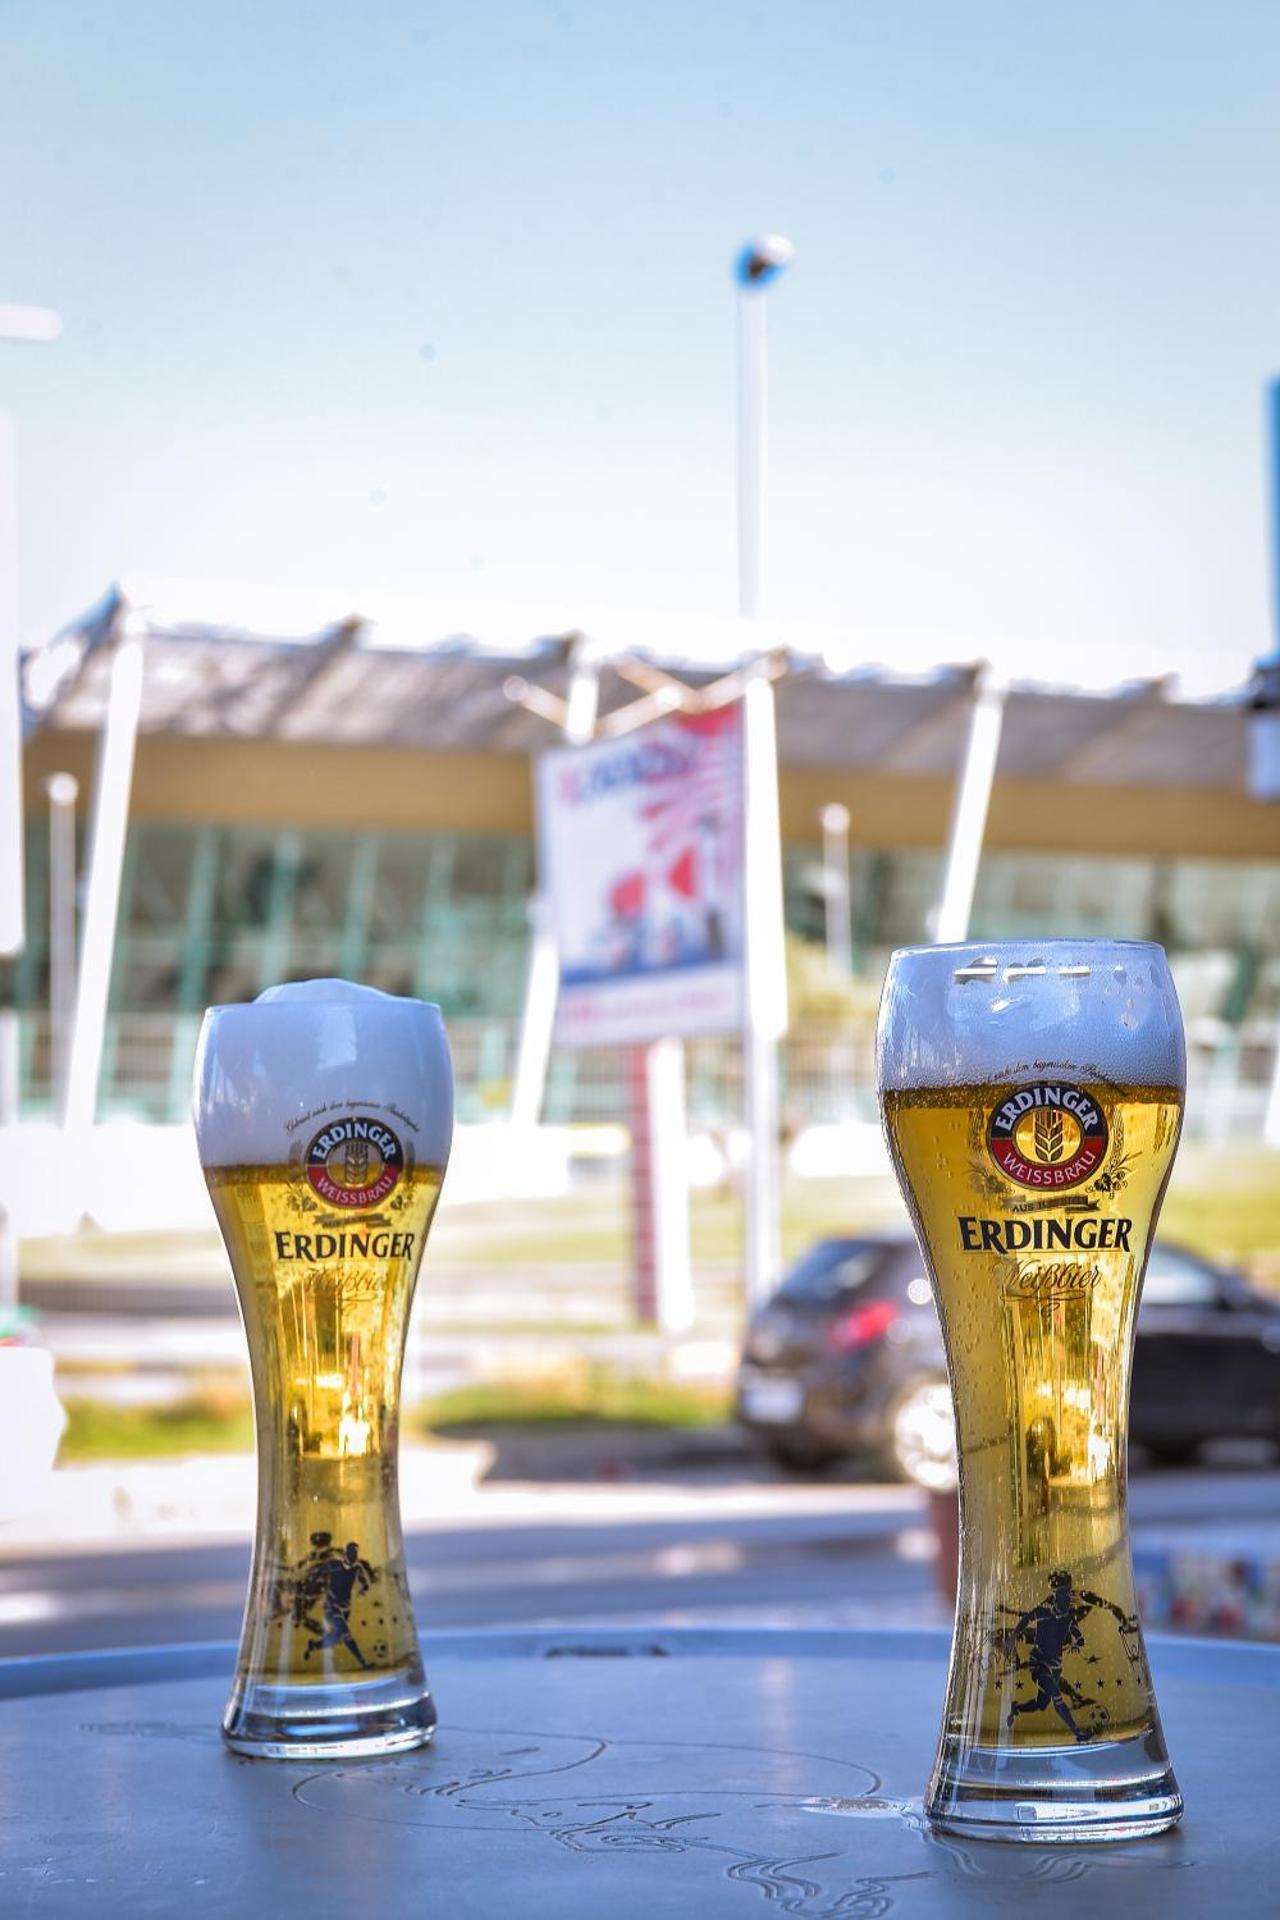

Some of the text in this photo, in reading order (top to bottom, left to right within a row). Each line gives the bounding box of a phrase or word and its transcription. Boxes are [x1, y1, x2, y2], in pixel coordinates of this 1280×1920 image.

[996, 1087, 1099, 1130] ERDINGER
[312, 1123, 397, 1159] ERDINGER
[1003, 1151, 1096, 1184] WEISSBRÄU
[275, 1231, 416, 1263] ERDINGER
[958, 1217, 1133, 1254] ERDINGER
[992, 1259, 1102, 1295] Weißbier
